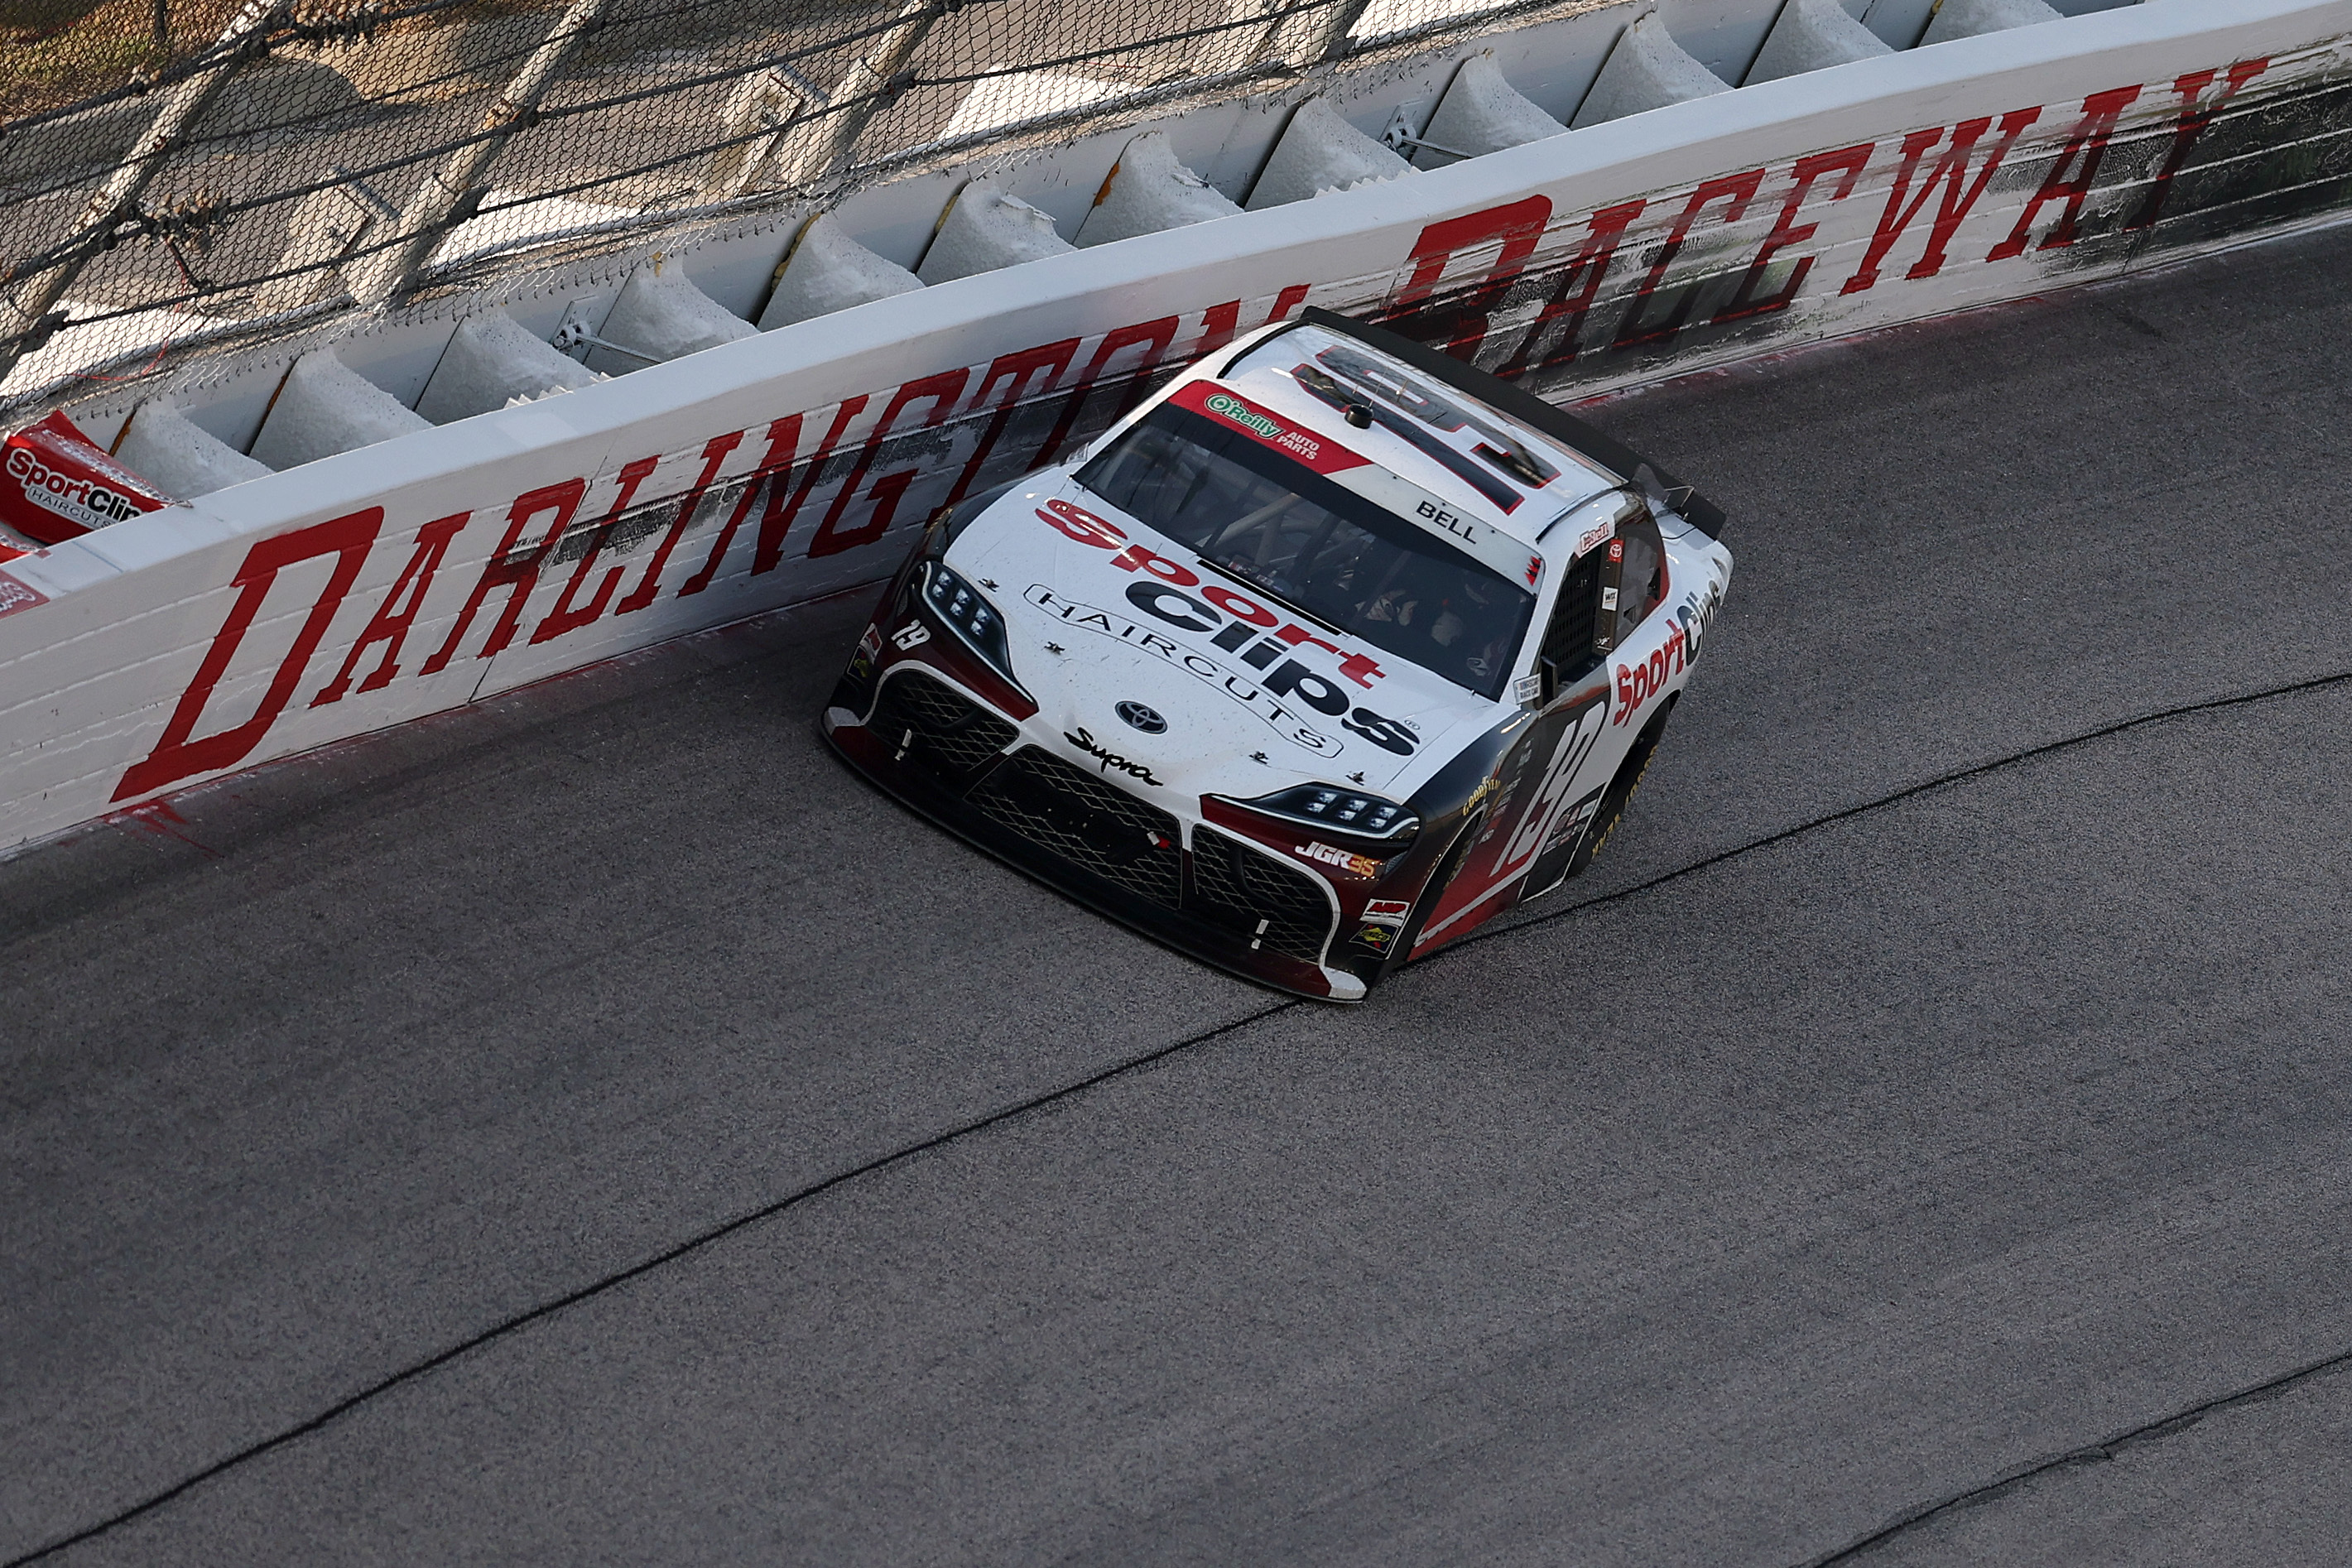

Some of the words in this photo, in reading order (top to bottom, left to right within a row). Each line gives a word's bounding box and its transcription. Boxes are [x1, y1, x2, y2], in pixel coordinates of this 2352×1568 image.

[1358, 58, 2269, 378] RACEWAY
[1206, 395, 1283, 437] O'Reilly
[1287, 431, 1320, 451] AUTO
[1276, 435, 1318, 460] PARTS
[7, 448, 150, 522] SportCli
[31, 489, 112, 528] HAIRCUTS
[1416, 500, 1477, 545] BELL
[1036, 499, 1387, 690] Sport
[891, 619, 931, 651] 19
[1038, 591, 1326, 749] HAIRCUTS
[1125, 580, 1421, 757] Clips
[1064, 727, 1163, 786] Supra
